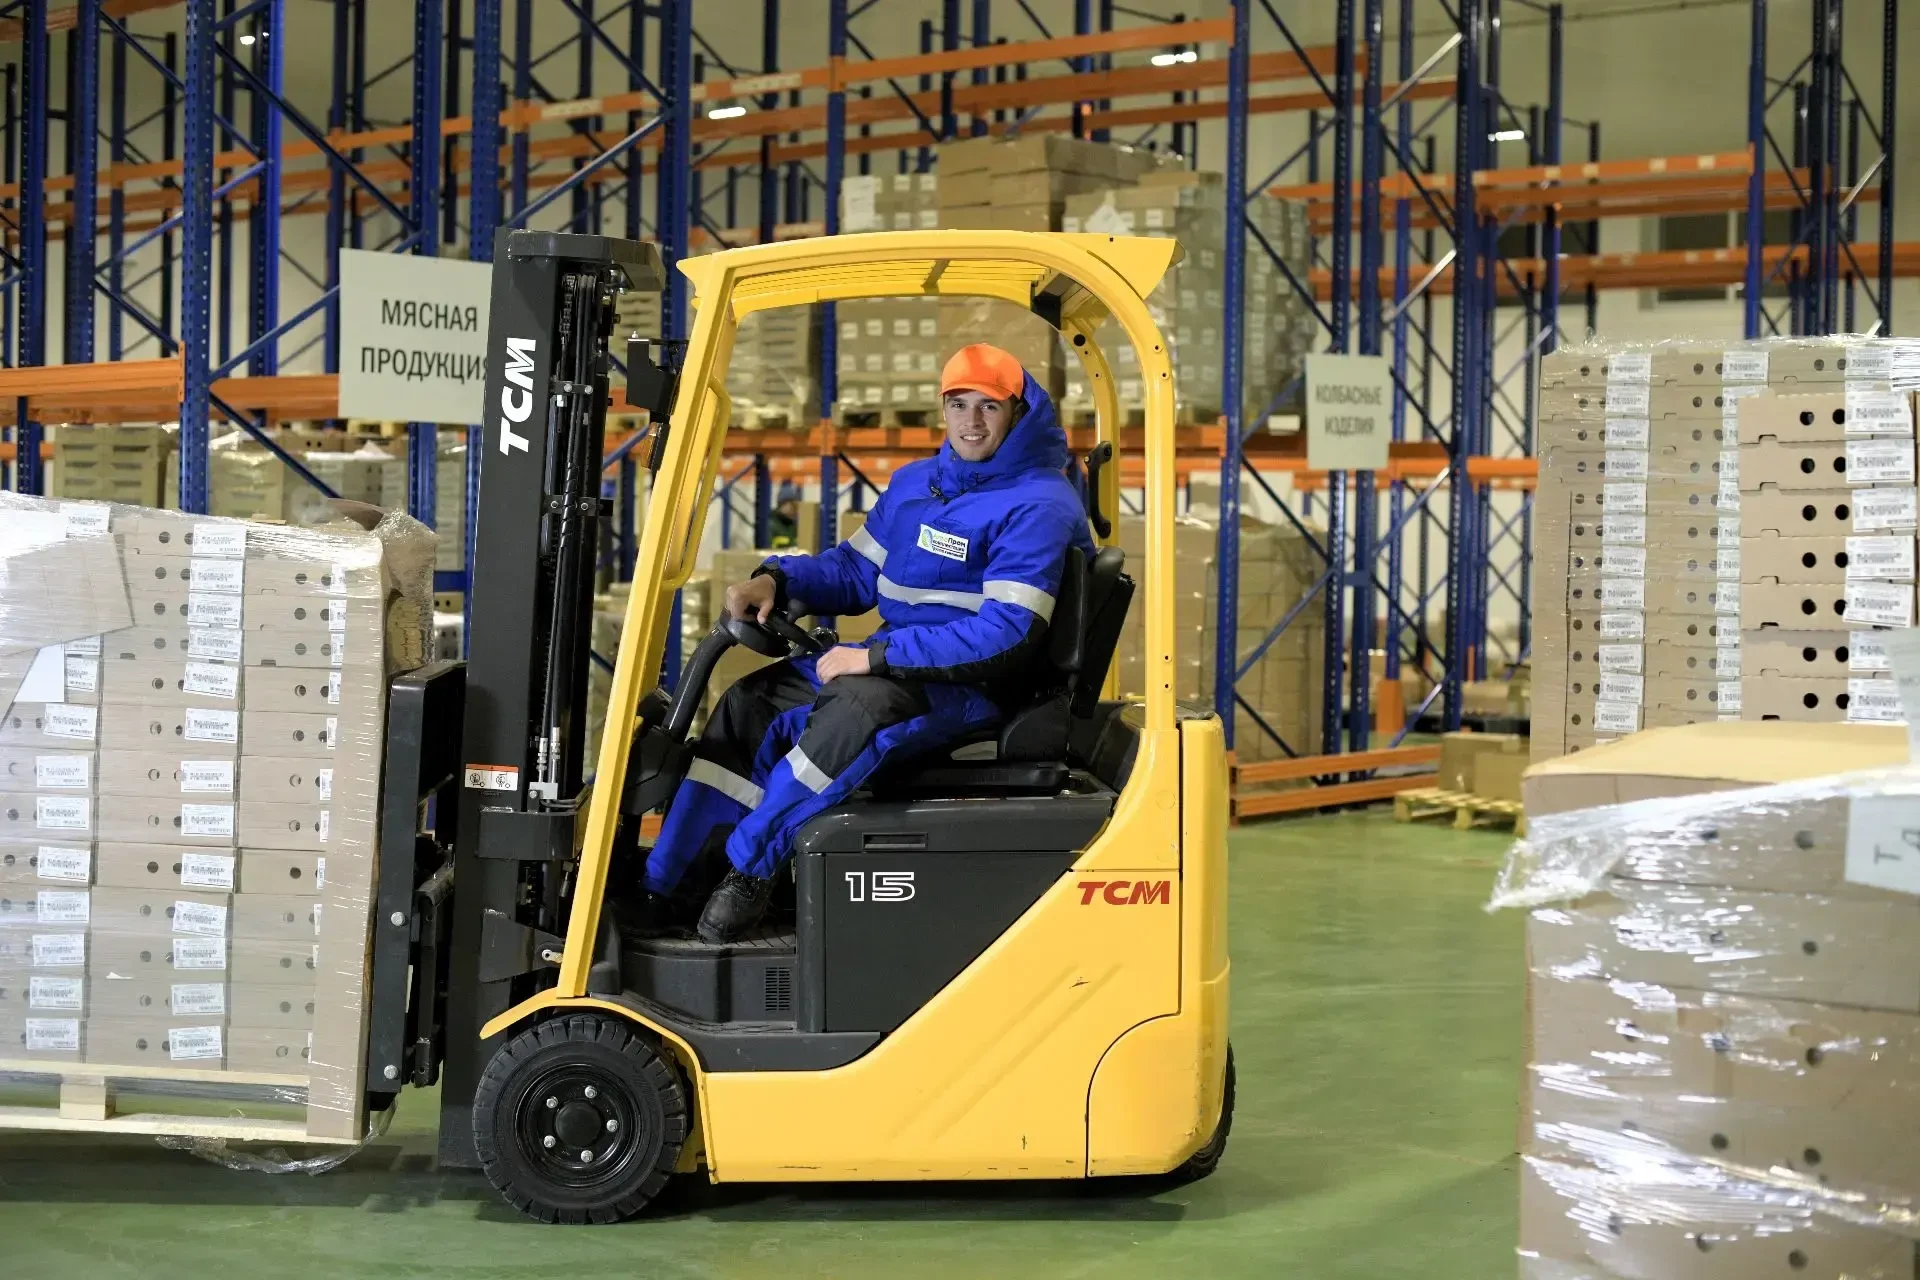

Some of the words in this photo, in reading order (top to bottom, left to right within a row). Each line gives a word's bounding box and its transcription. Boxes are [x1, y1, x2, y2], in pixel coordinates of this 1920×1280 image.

[381, 299, 478, 332] МЯСНАЯ
[500, 337, 537, 456] TCM
[845, 871, 916, 902] 15
[1077, 880, 1171, 906] TCM
